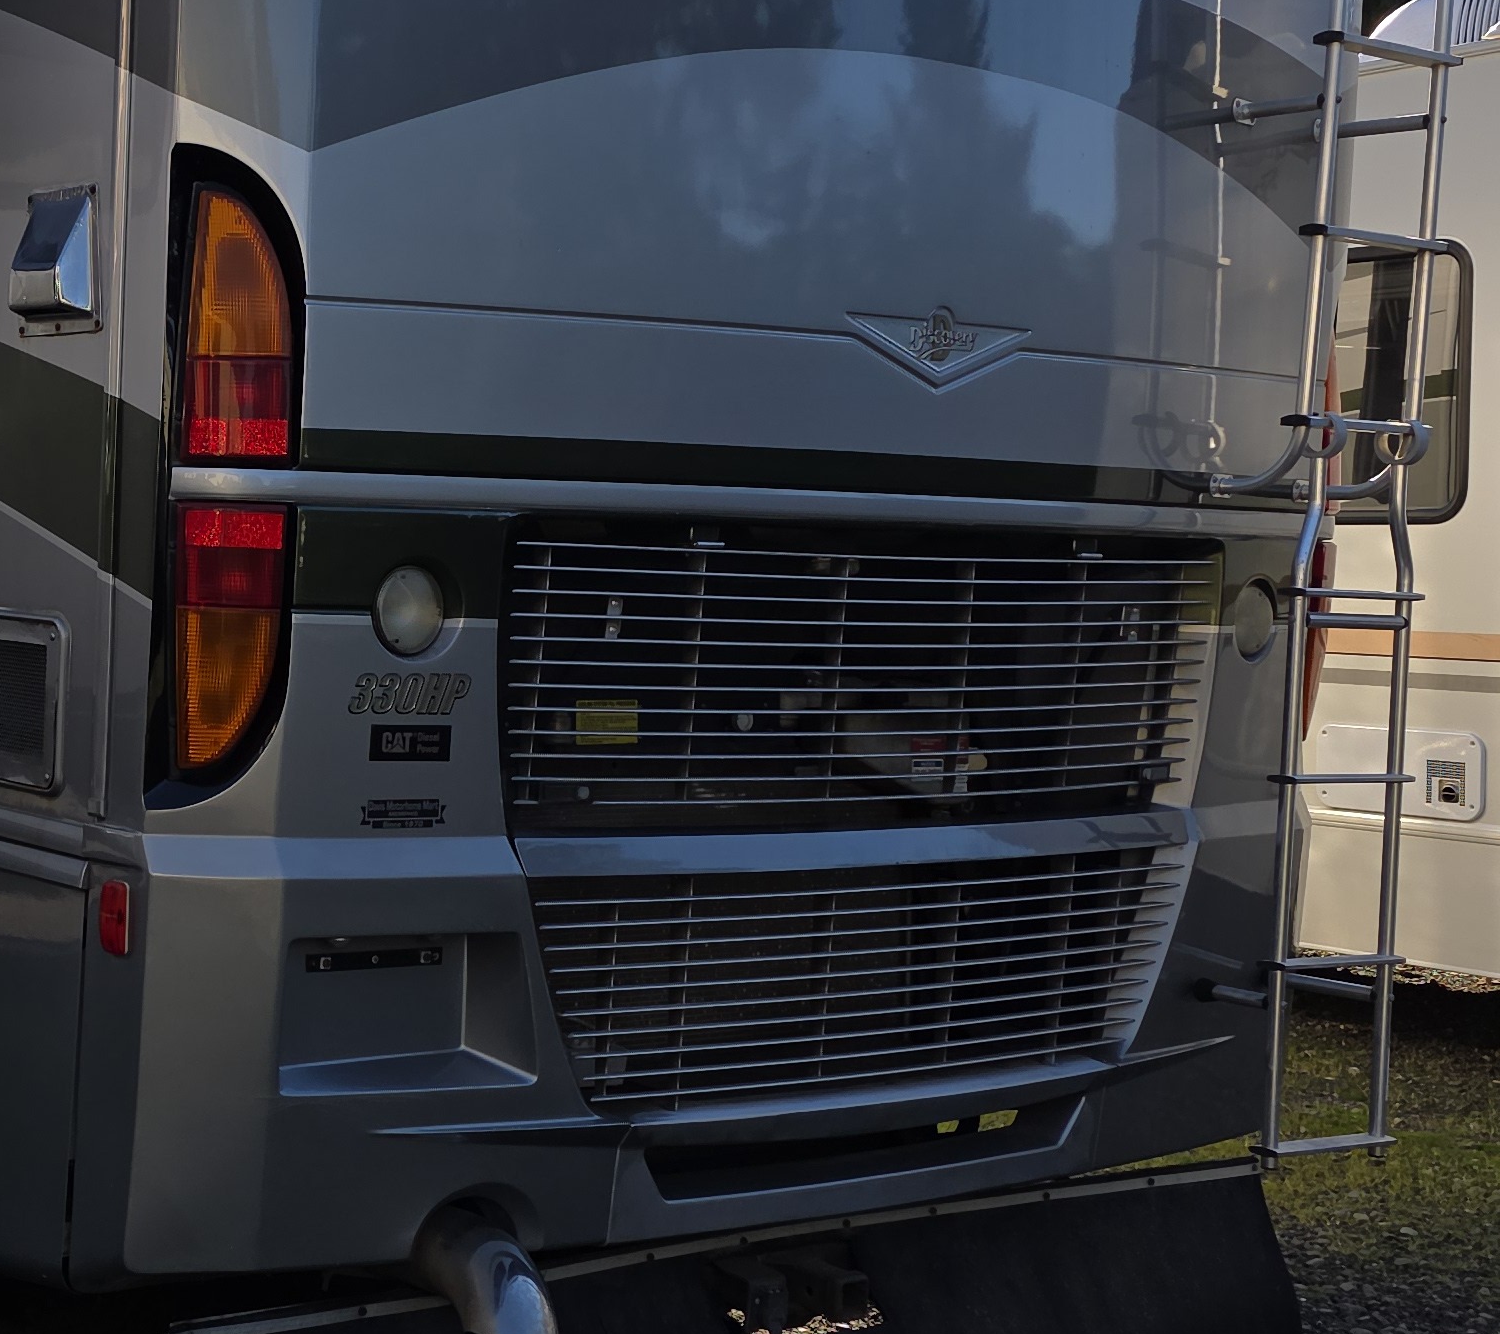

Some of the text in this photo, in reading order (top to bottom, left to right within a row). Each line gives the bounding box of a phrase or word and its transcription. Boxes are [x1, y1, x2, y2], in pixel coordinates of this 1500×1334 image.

[909, 321, 978, 354] Discovery
[348, 672, 472, 716] 330HP
[381, 731, 413, 754] CAT
